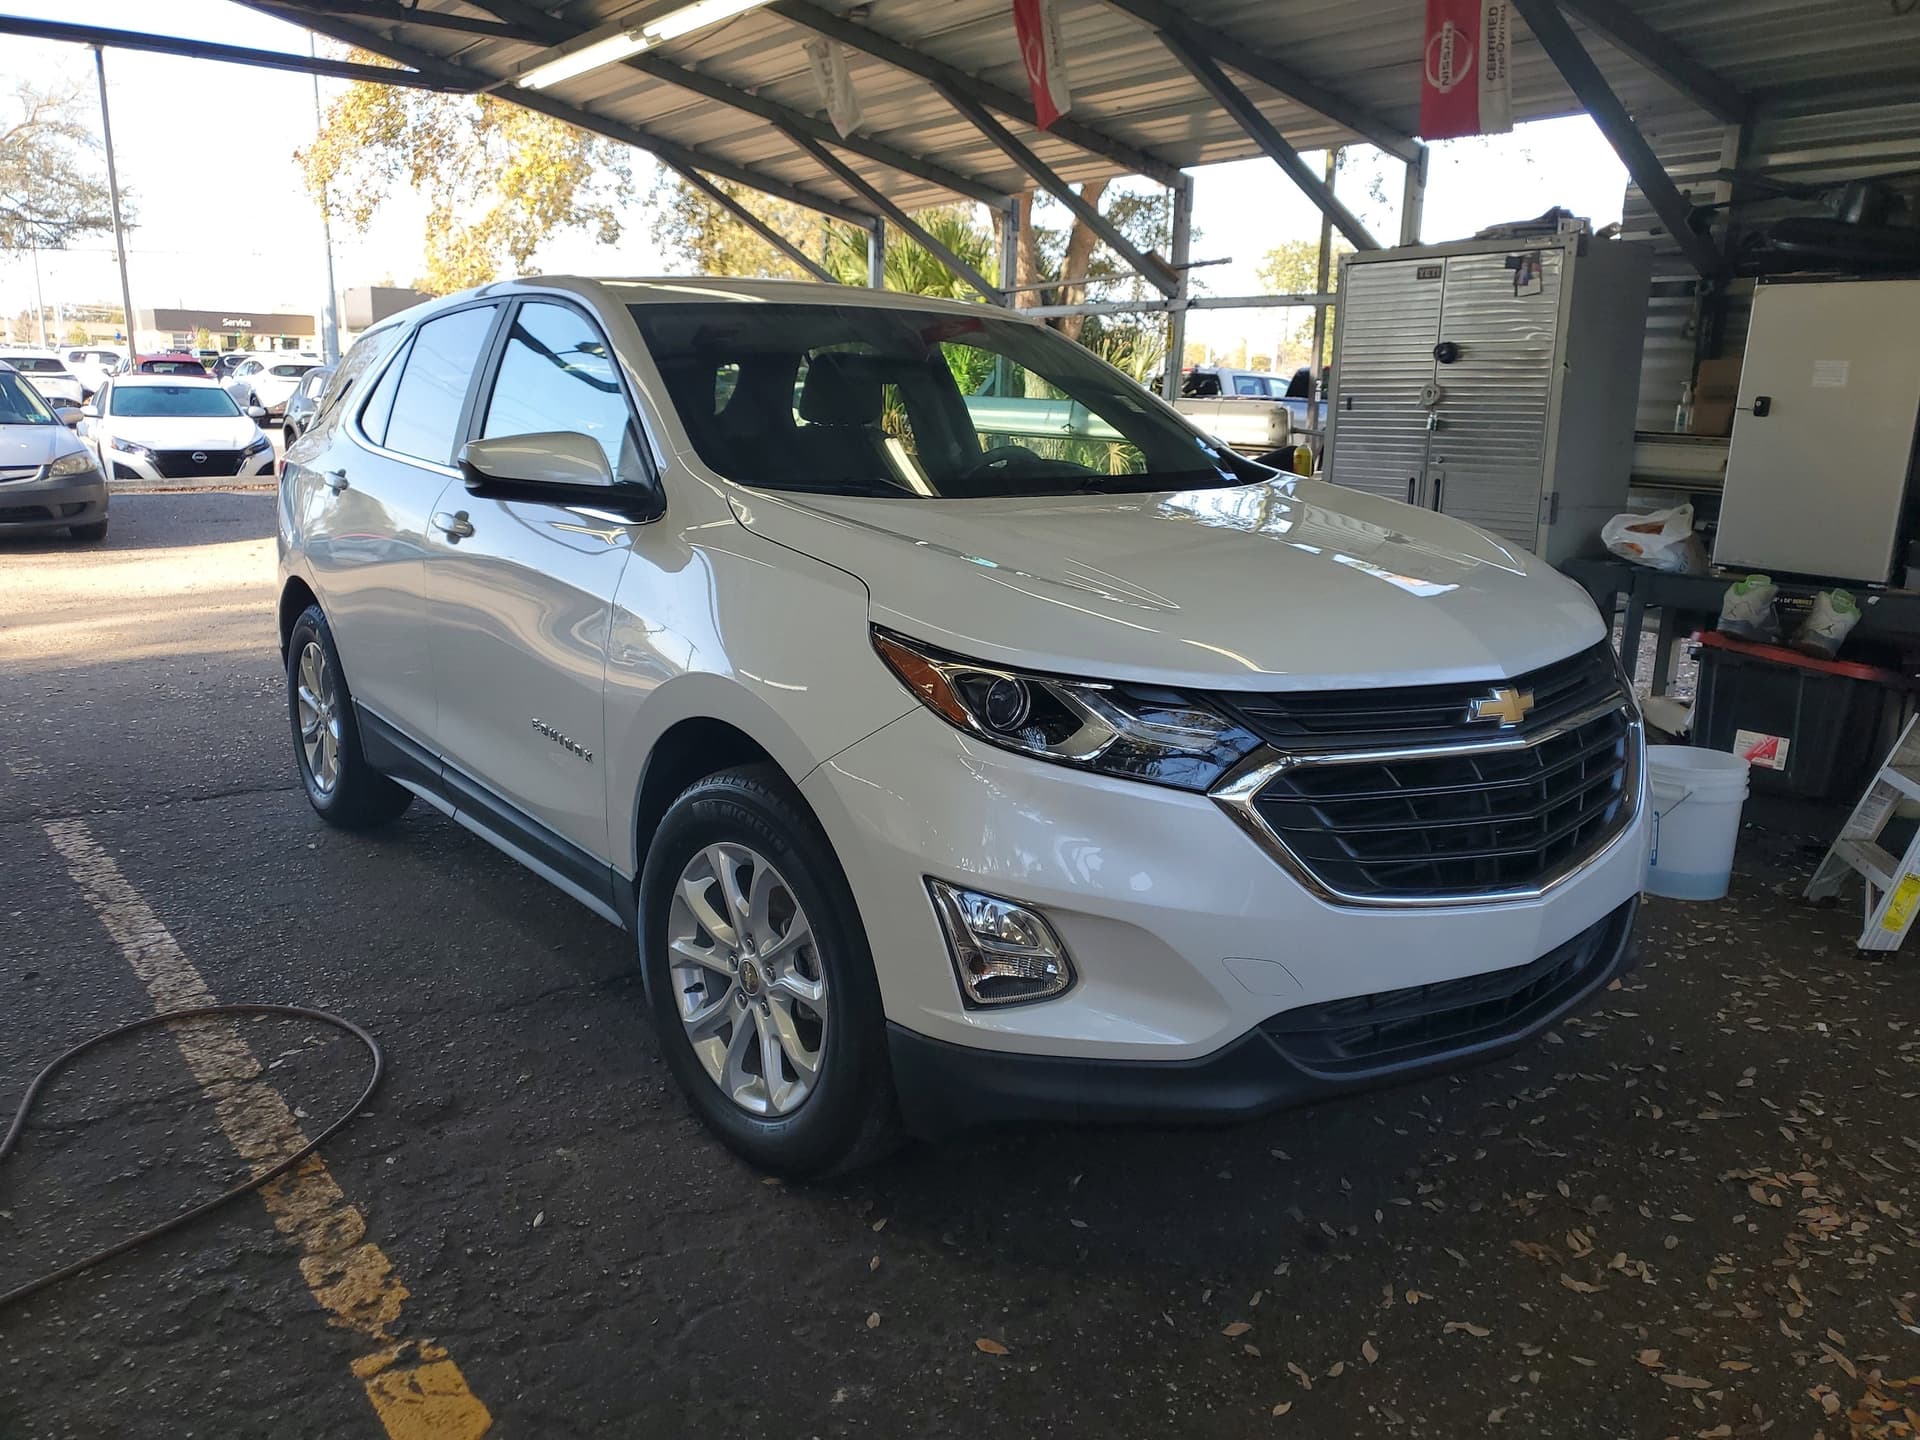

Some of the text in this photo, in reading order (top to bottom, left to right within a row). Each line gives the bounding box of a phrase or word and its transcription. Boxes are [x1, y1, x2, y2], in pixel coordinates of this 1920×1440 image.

[1440, 27, 1452, 87] NISSAN
[1486, 6, 1498, 81] CERTIFIED
[1418, 268, 1440, 278] YETI
[222, 318, 251, 328] Service
[531, 717, 593, 764] EQUINOX
[720, 803, 785, 852] MICHELIN
